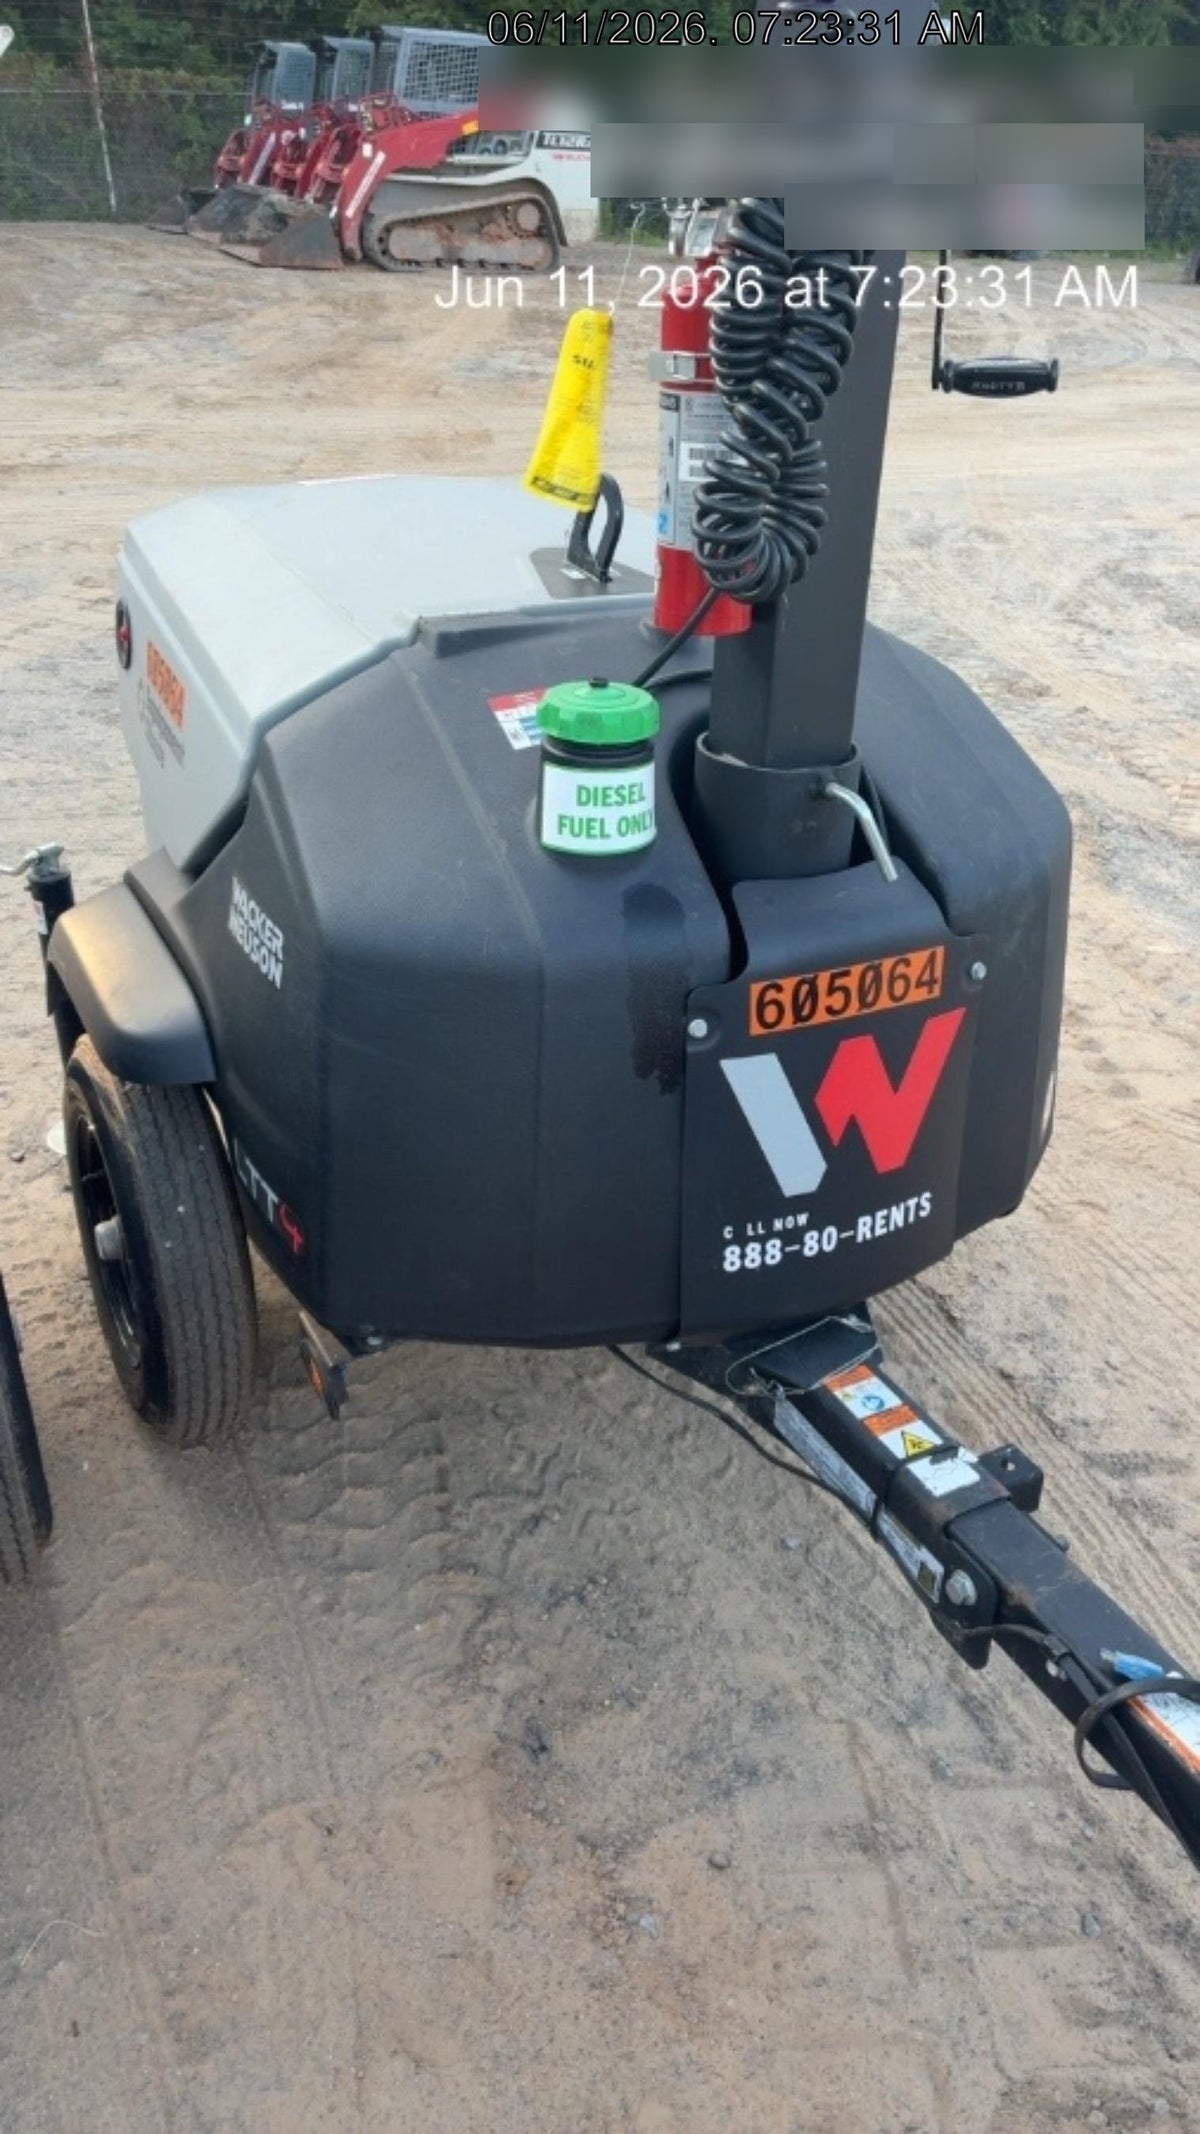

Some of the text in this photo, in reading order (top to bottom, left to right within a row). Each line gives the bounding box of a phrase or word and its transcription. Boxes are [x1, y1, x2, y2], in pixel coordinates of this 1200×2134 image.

[557, 813, 611, 840] FUEL
[576, 782, 646, 807] DIESEL
[228, 903, 283, 990] NEUSON
[232, 875, 284, 961] WACKER
[755, 950, 938, 1031] 605064
[722, 1192, 932, 1273] 888-80-RENTS
[772, 1212, 809, 1233] NOW
